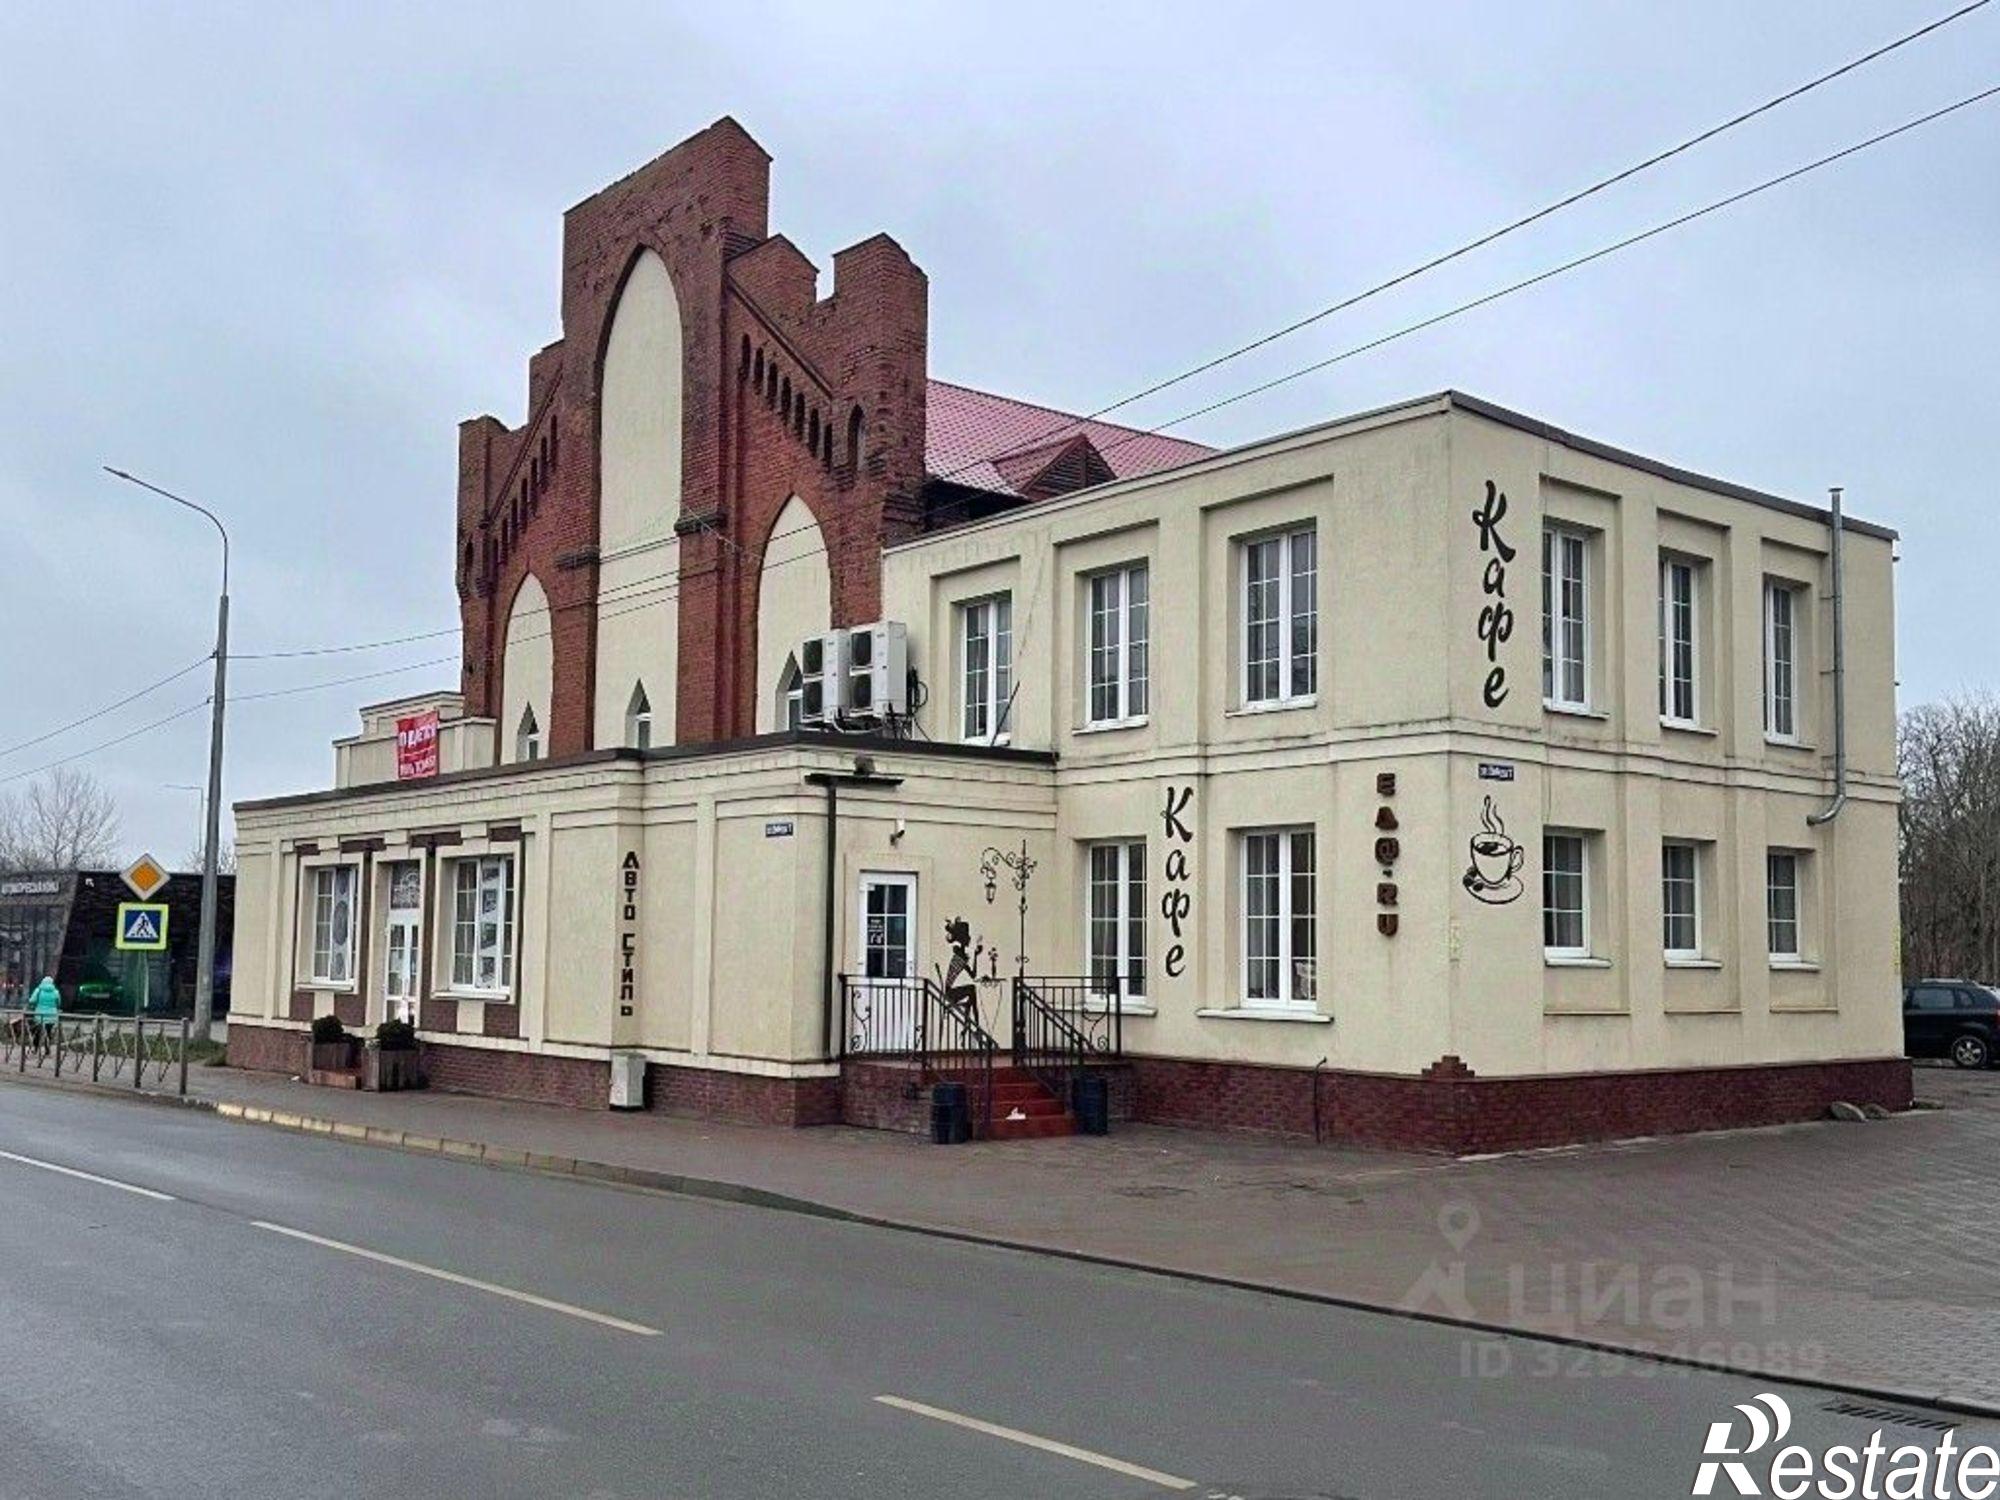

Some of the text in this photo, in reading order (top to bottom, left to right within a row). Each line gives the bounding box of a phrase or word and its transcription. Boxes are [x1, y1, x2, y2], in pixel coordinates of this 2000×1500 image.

[1472, 479, 1517, 709] Кафе
[622, 850, 640, 921] АВТО
[1159, 786, 1194, 978] Кафе
